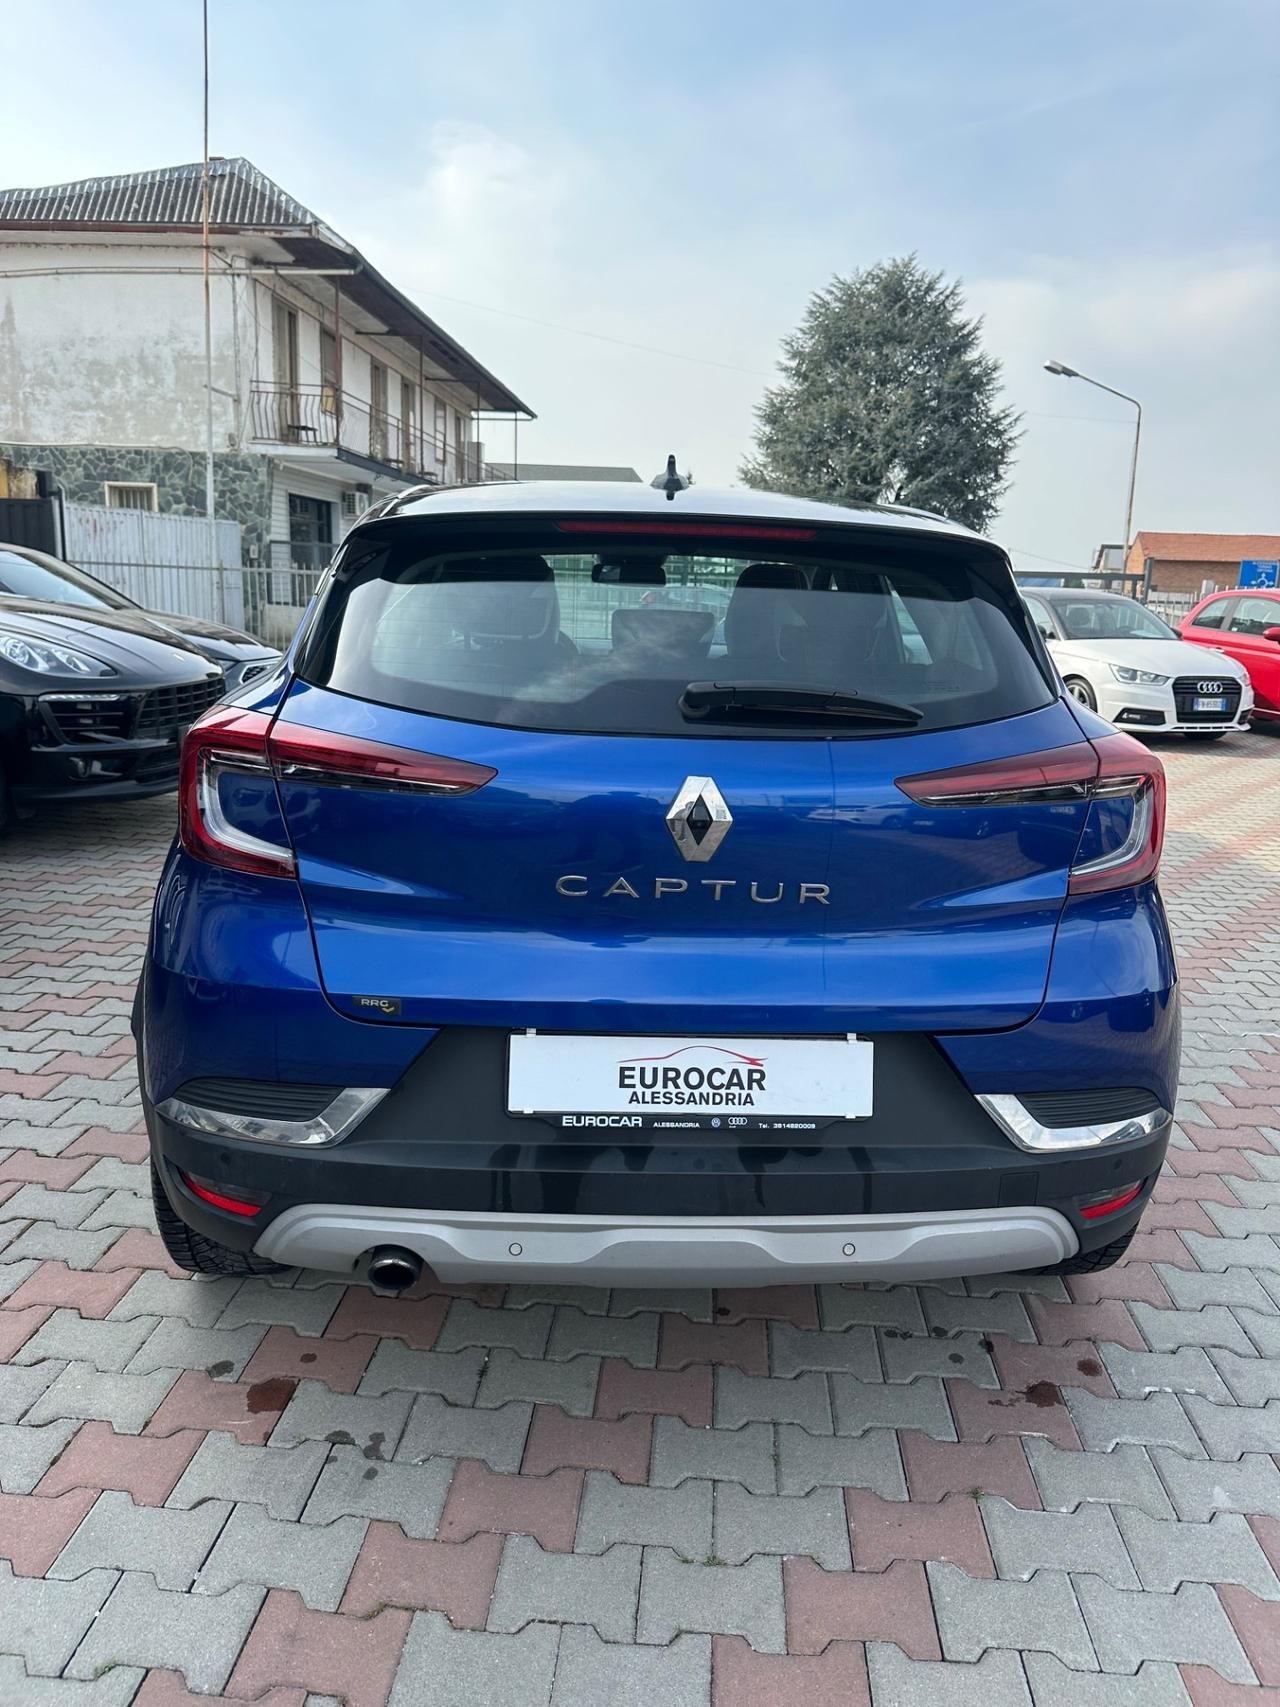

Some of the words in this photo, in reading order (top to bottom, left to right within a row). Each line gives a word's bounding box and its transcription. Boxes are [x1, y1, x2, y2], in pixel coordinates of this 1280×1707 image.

[555, 875, 831, 905] CAPTUR
[361, 998, 389, 1007] RRG
[618, 1066, 767, 1091] EUROCAR
[628, 1090, 755, 1106] ALESSANDRIA
[562, 1115, 643, 1127] EUROCAR
